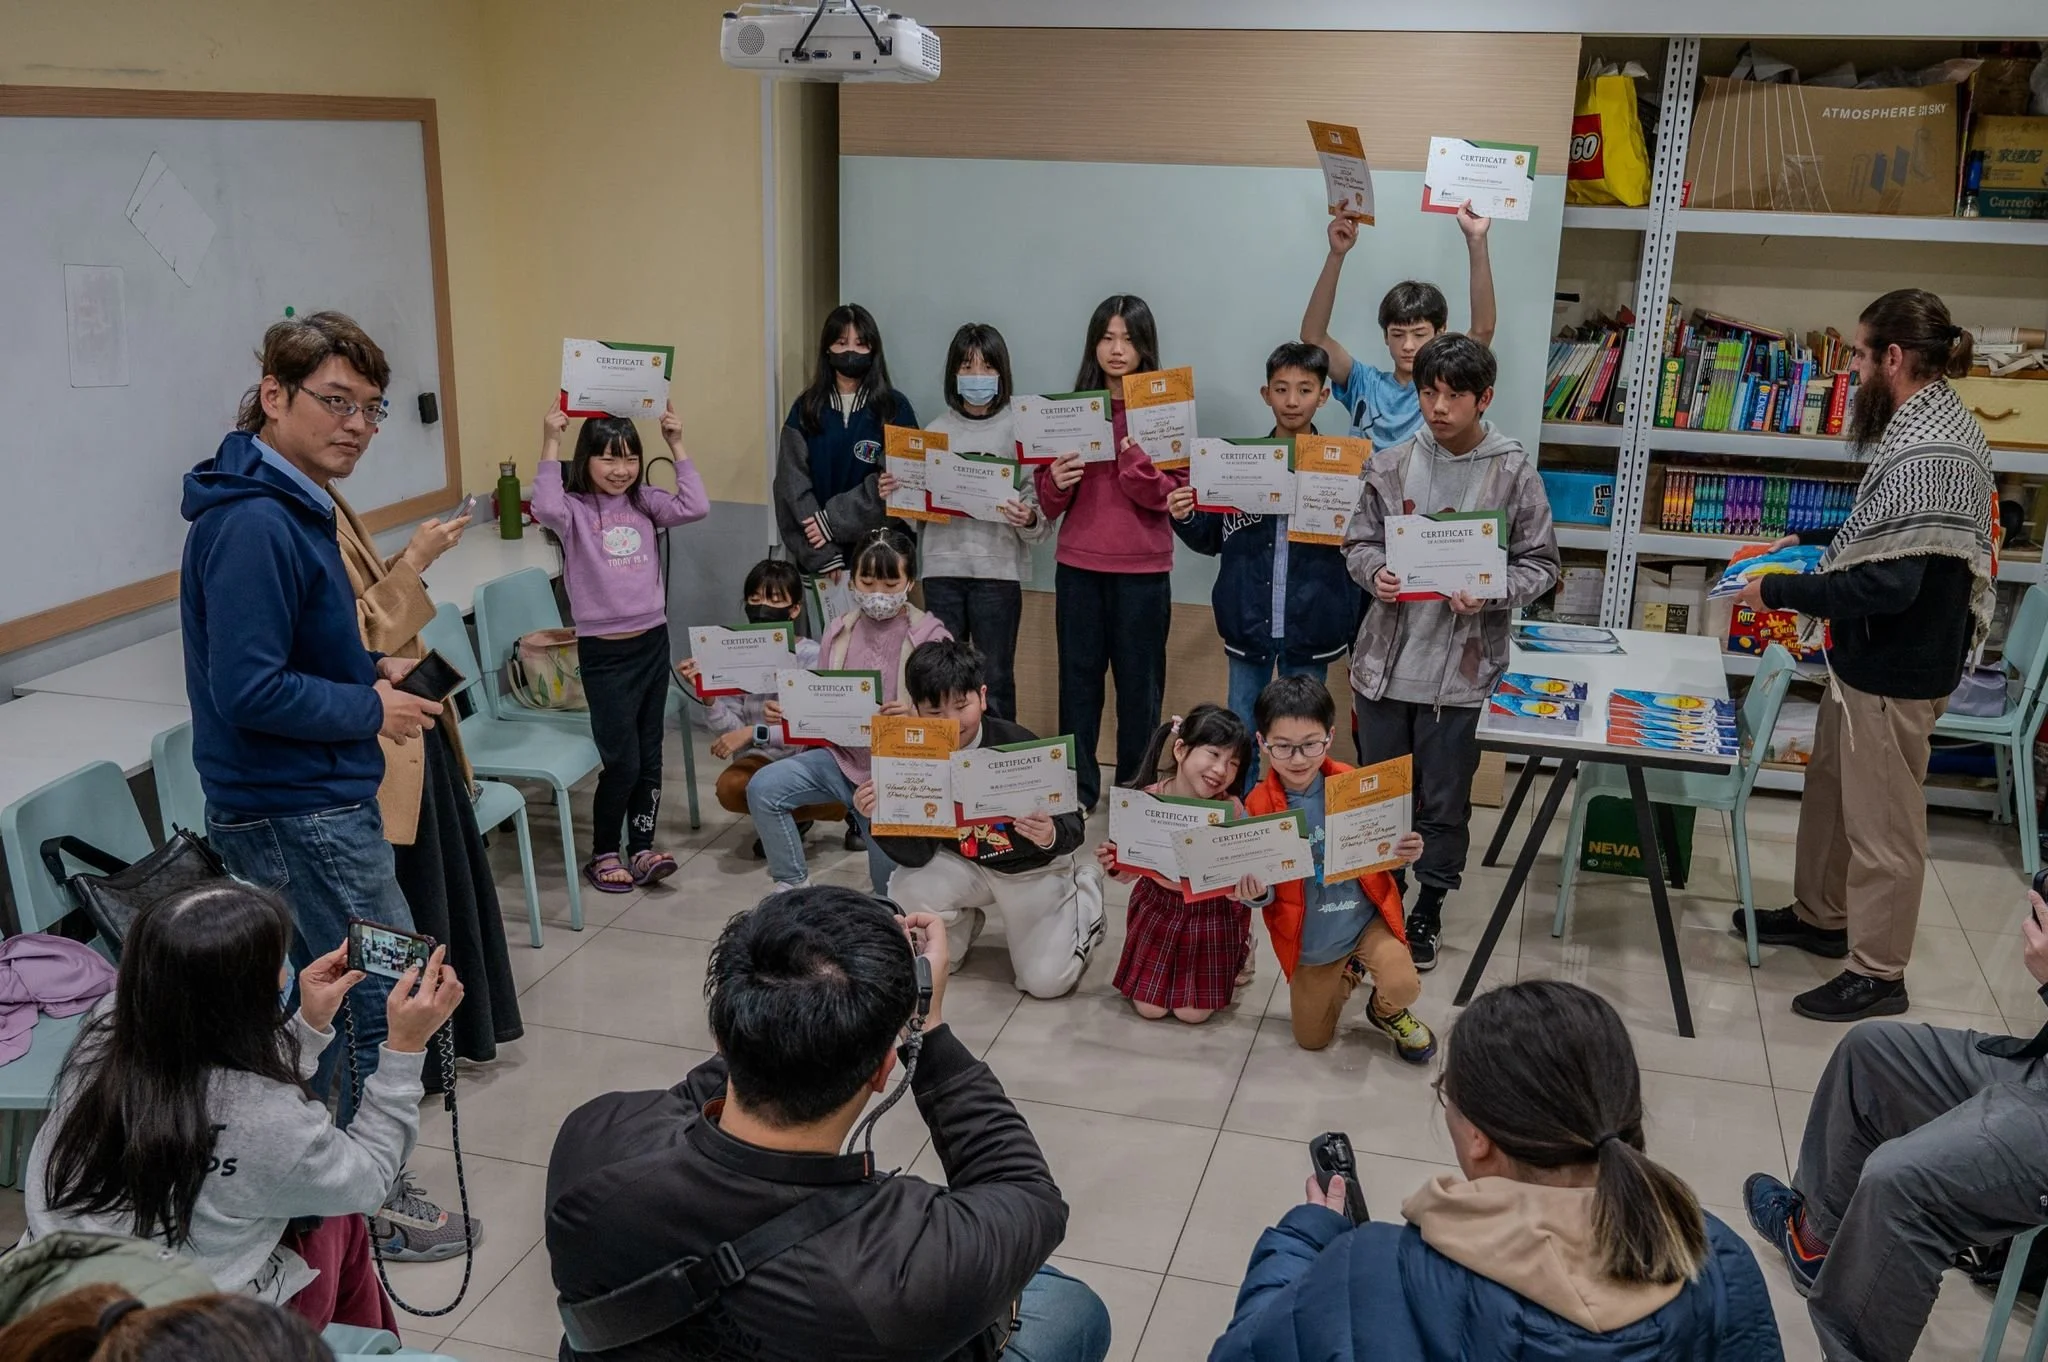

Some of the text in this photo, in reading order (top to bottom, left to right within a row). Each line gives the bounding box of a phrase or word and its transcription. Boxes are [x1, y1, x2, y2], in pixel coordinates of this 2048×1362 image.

[1822, 106, 1916, 120] ATMOSPHERE
[1927, 103, 1946, 115] SKY
[1570, 132, 1600, 162] GO
[1460, 154, 1507, 165] CERTIFICATE
[596, 356, 645, 366] CERTIFICATE
[1040, 406, 1084, 415] CERTIFICATE
[953, 465, 995, 476] CERTIFICATE
[1421, 529, 1474, 539] CERTIFICATE
[608, 556, 631, 567] TODAY
[1738, 610, 1756, 623] RITZ
[721, 637, 767, 646] CERTIFICATE
[808, 684, 854, 692] CERTIFICATE
[988, 756, 1042, 770] CERTIFICATE
[1144, 809, 1199, 823] CERTIFICATE
[1157, 820, 1189, 828] ACHIEVEMENT
[1212, 828, 1270, 844] CERTIFICATE
[1588, 841, 1640, 858] NEVIA
